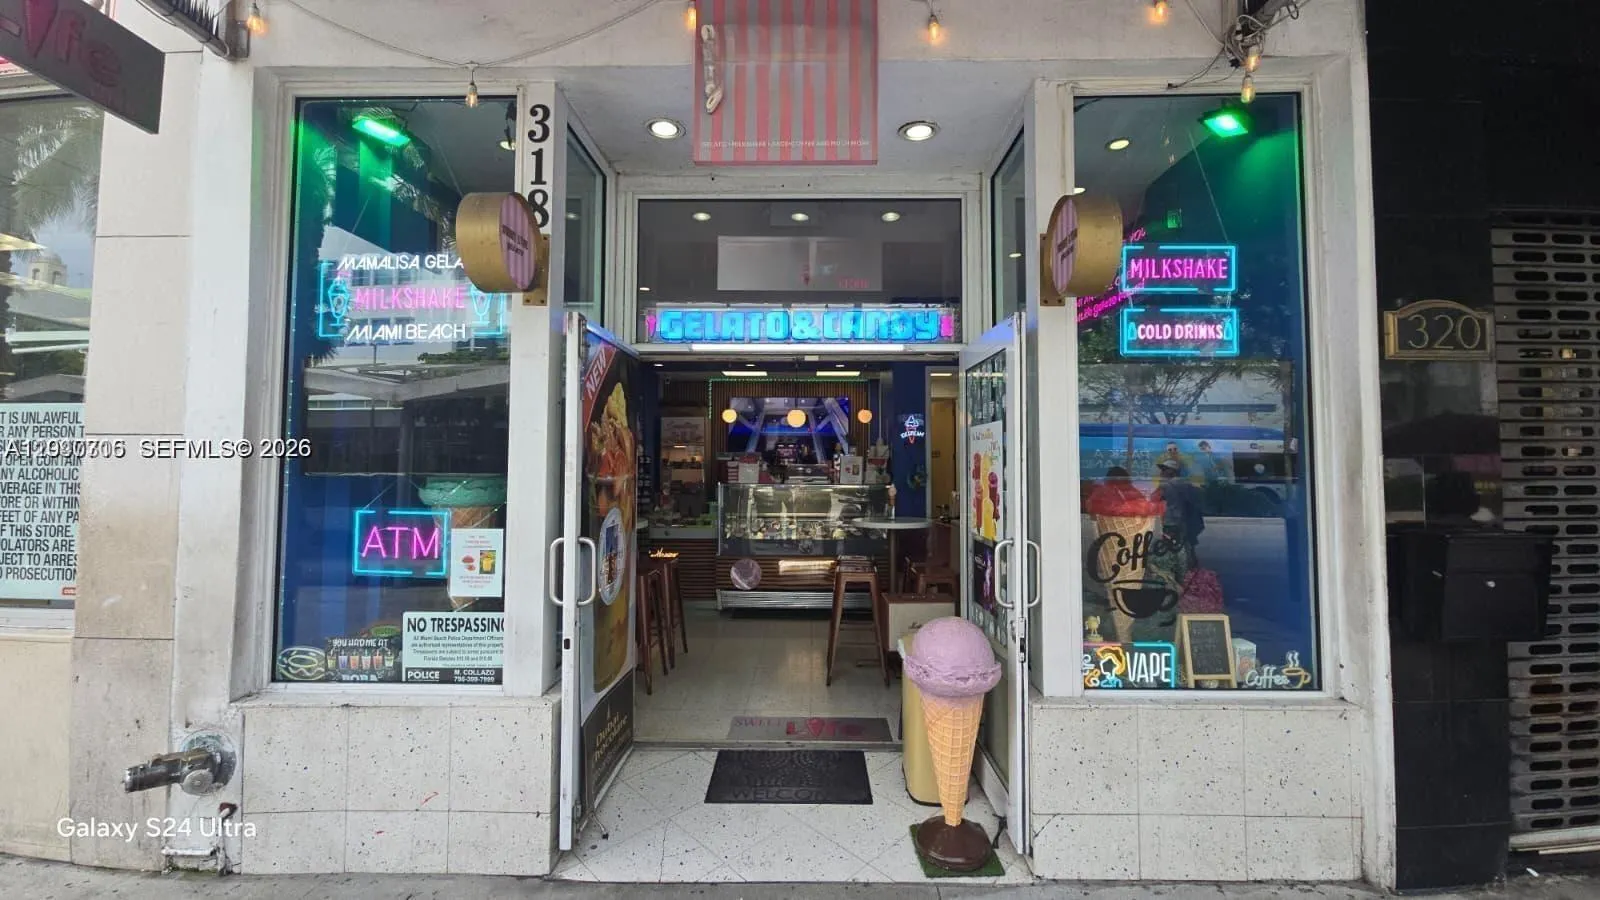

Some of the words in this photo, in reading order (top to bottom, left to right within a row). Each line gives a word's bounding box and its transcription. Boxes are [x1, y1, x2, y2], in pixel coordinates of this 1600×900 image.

[527, 103, 551, 228] 318
[337, 254, 420, 270] MAMALISA
[1129, 258, 1229, 280] MILKSHAKE
[355, 286, 467, 310] MILKSHAKE
[347, 324, 402, 341] MIAMI
[406, 323, 466, 341] BEACH
[1137, 323, 1172, 340] COLD
[1174, 322, 1225, 340] DRINKS
[1407, 314, 1481, 350] 320
[585, 346, 607, 401] NEW
[8, 411, 18, 424] IS
[21, 411, 82, 424] UNLAWFUL
[7, 425, 29, 438] ANY
[32, 425, 75, 438] PERSON
[18, 468, 80, 480] ALCOHOLIC
[45, 482, 56, 494] IN
[0, 496, 21, 509] ORE
[24, 496, 39, 509] OR
[24, 510, 38, 523] OF
[40, 510, 63, 523] ANY
[9, 524, 32, 537] THIS
[35, 524, 74, 538] STORE.
[52, 539, 76, 552] ARE
[361, 525, 440, 560] ATM
[28, 553, 41, 566] TO
[407, 617, 427, 633] NO
[407, 671, 440, 679] POLICE
[1125, 651, 1172, 683] VAPE
